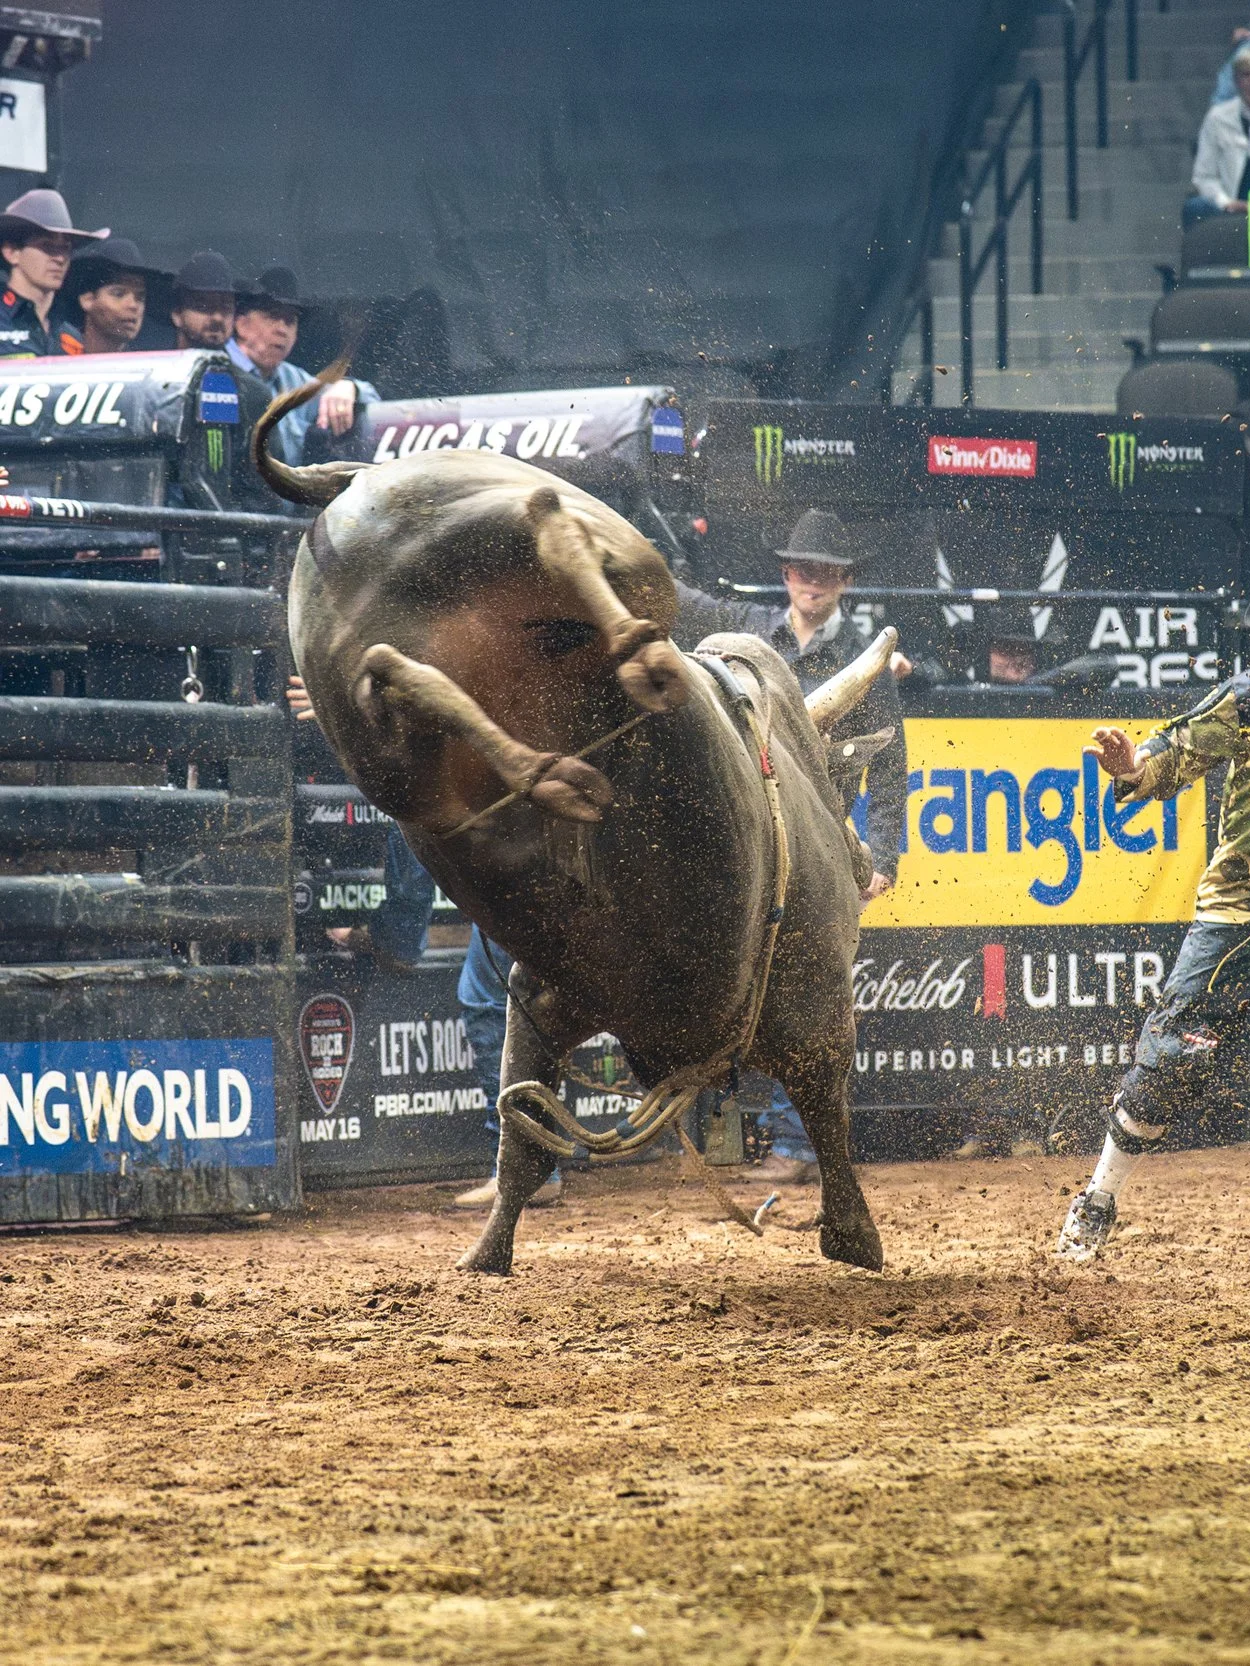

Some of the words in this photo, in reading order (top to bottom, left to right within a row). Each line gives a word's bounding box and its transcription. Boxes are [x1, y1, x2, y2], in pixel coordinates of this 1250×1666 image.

[373, 419, 512, 463] LUCAS
[1089, 606, 1199, 649] AIR
[353, 805, 394, 824] ULTR
[850, 751, 1194, 907] rangler
[1022, 952, 1172, 1009] ULTR
[379, 1020, 428, 1076] LET'S
[855, 1049, 975, 1075] UPERIOR
[991, 1046, 1068, 1069] LIGHT
[1083, 1043, 1137, 1066] BEE
[575, 1096, 606, 1118] MAY
[300, 1119, 337, 1143] MAY
[337, 1116, 361, 1140] 16
